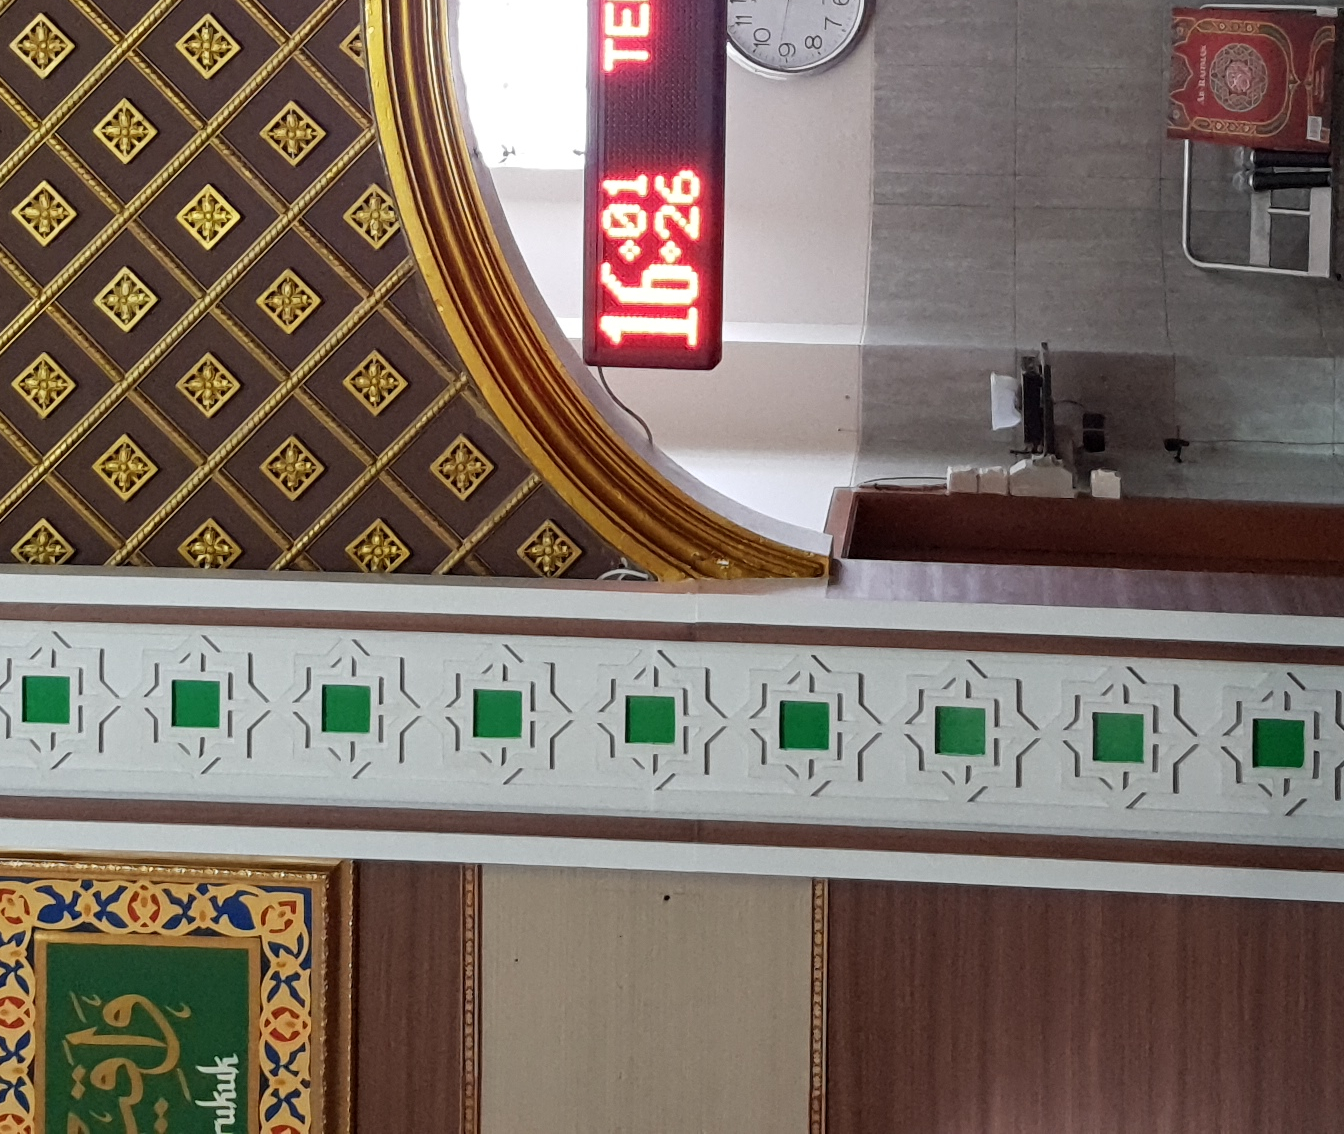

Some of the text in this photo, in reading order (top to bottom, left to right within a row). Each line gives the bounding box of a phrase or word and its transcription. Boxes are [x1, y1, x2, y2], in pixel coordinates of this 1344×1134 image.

[735, 16, 752, 26] 11
[824, 17, 842, 30] 7
[753, 28, 770, 46] 10
[805, 35, 822, 49] 8
[778, 43, 796, 57] 9
